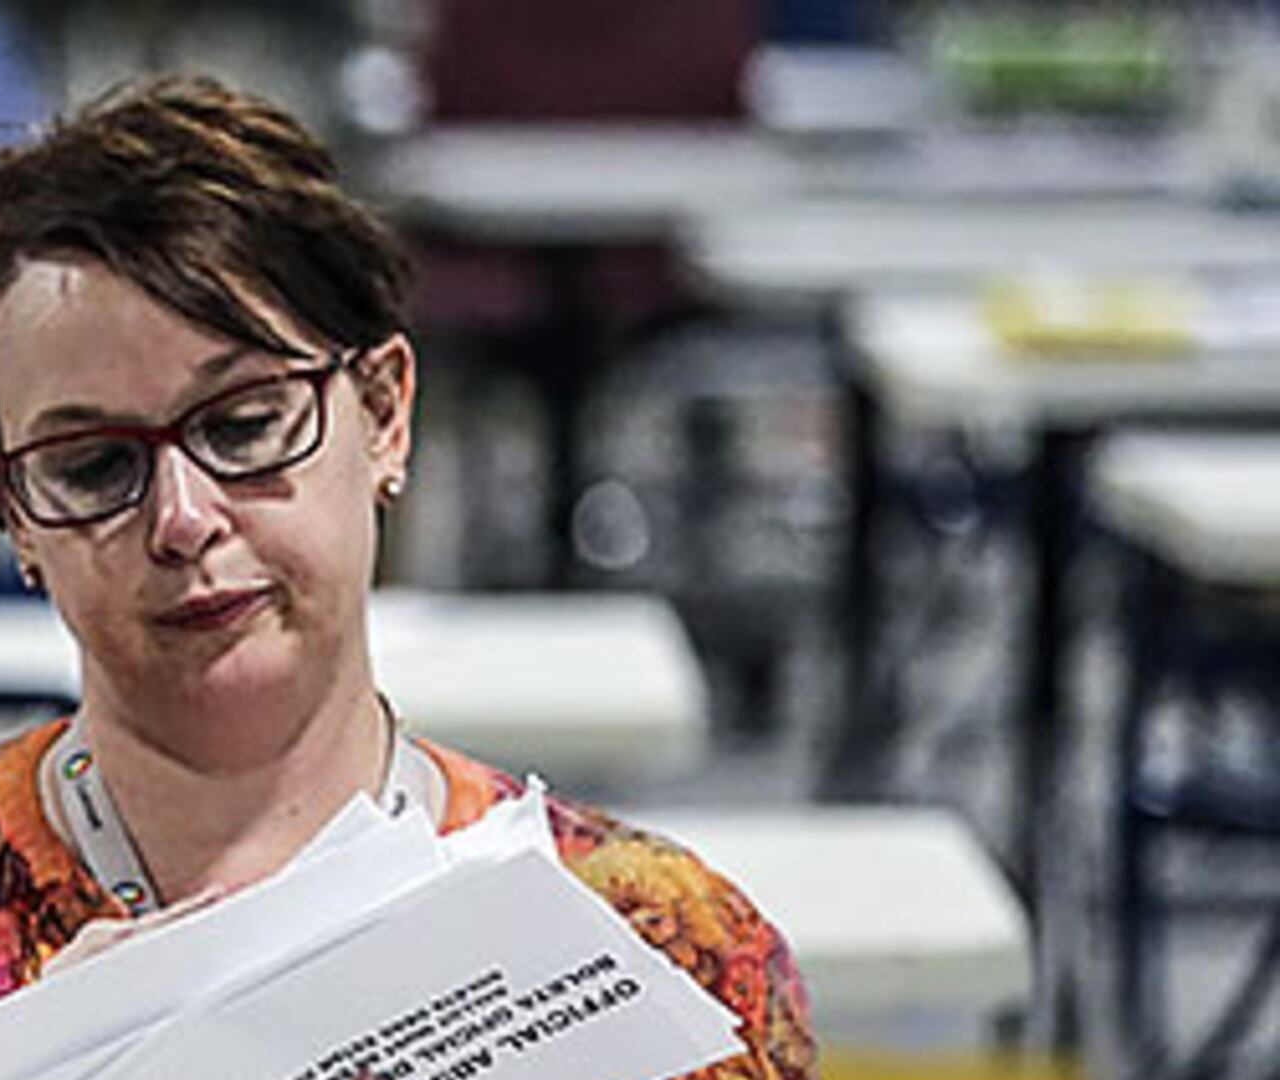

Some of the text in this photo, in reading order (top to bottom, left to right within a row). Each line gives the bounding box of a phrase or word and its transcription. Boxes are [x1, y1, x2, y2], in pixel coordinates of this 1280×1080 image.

[515, 955, 616, 1010] BOLETA
[414, 1007, 513, 1062] OFICIAL
[496, 979, 640, 1051] OFFICIAL
